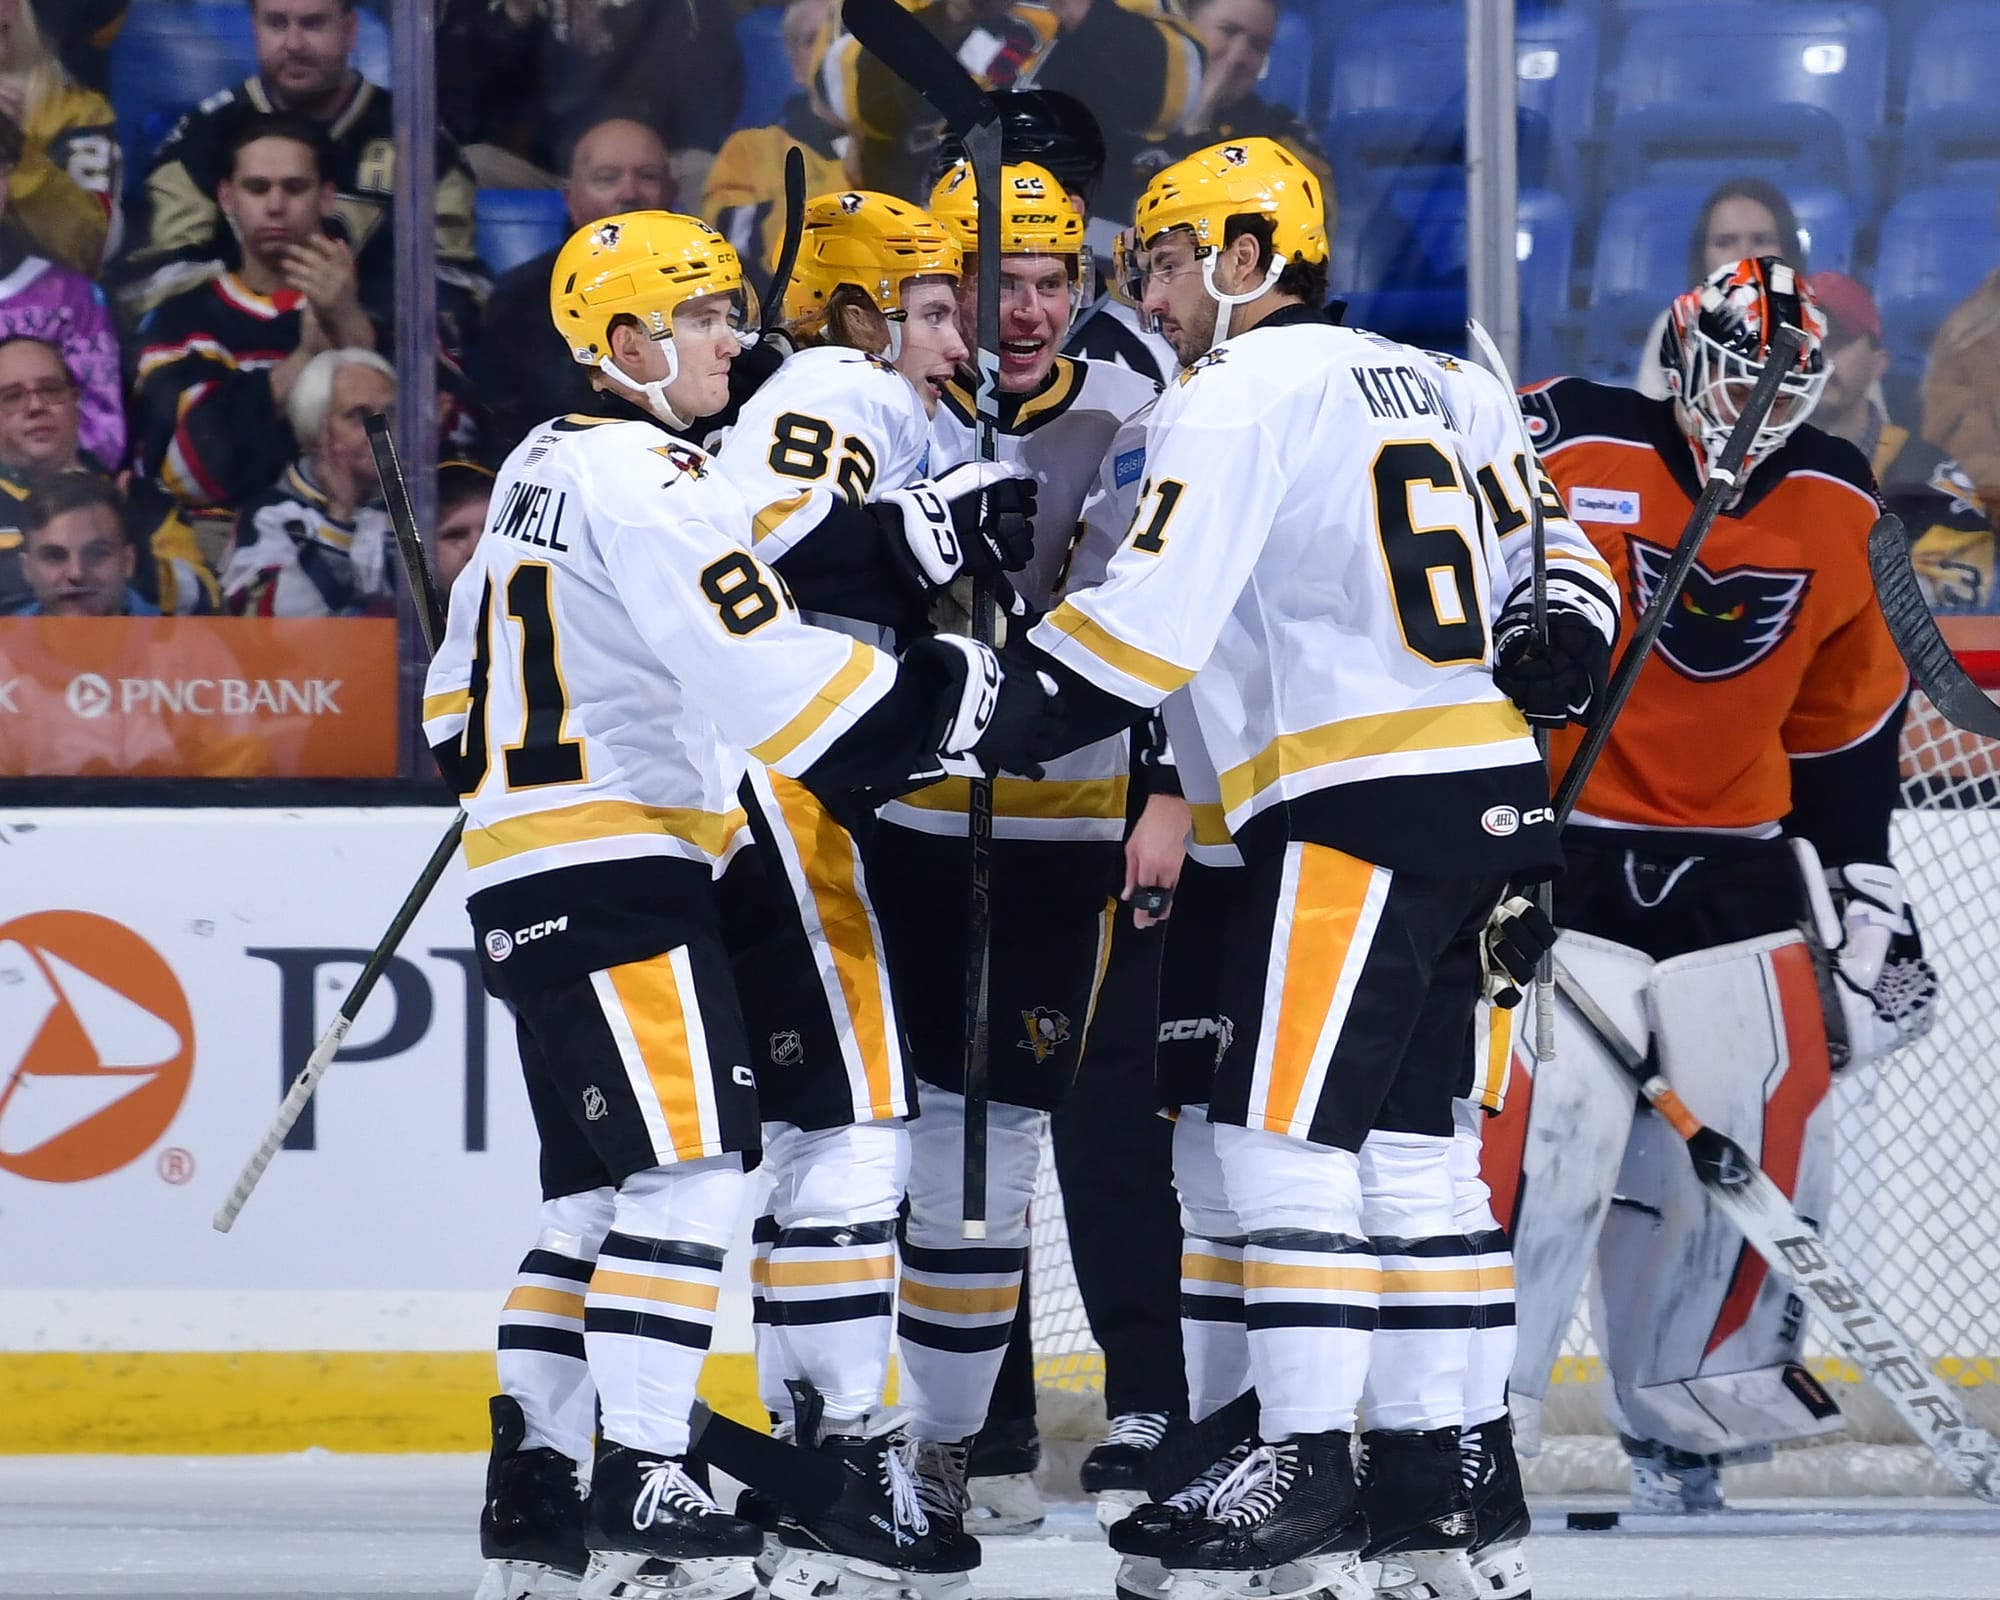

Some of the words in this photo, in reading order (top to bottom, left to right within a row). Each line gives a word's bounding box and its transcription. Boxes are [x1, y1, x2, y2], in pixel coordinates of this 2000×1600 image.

[1010, 213, 1059, 224] CCM
[1013, 177, 1045, 190] 22
[716, 252, 736, 264] CC
[765, 409, 879, 511] 82
[491, 480, 569, 553] OWELL
[903, 482, 959, 566] CC
[1129, 475, 1189, 558] 1
[1367, 437, 1492, 669] 6
[697, 547, 797, 640] 8
[118, 679, 216, 715] PNC
[219, 679, 343, 715] BANK
[972, 777, 991, 916] JETSP
[514, 915, 569, 946] CCM
[1157, 1017, 1222, 1043] CCM
[1773, 1235, 1962, 1433] BAUER
